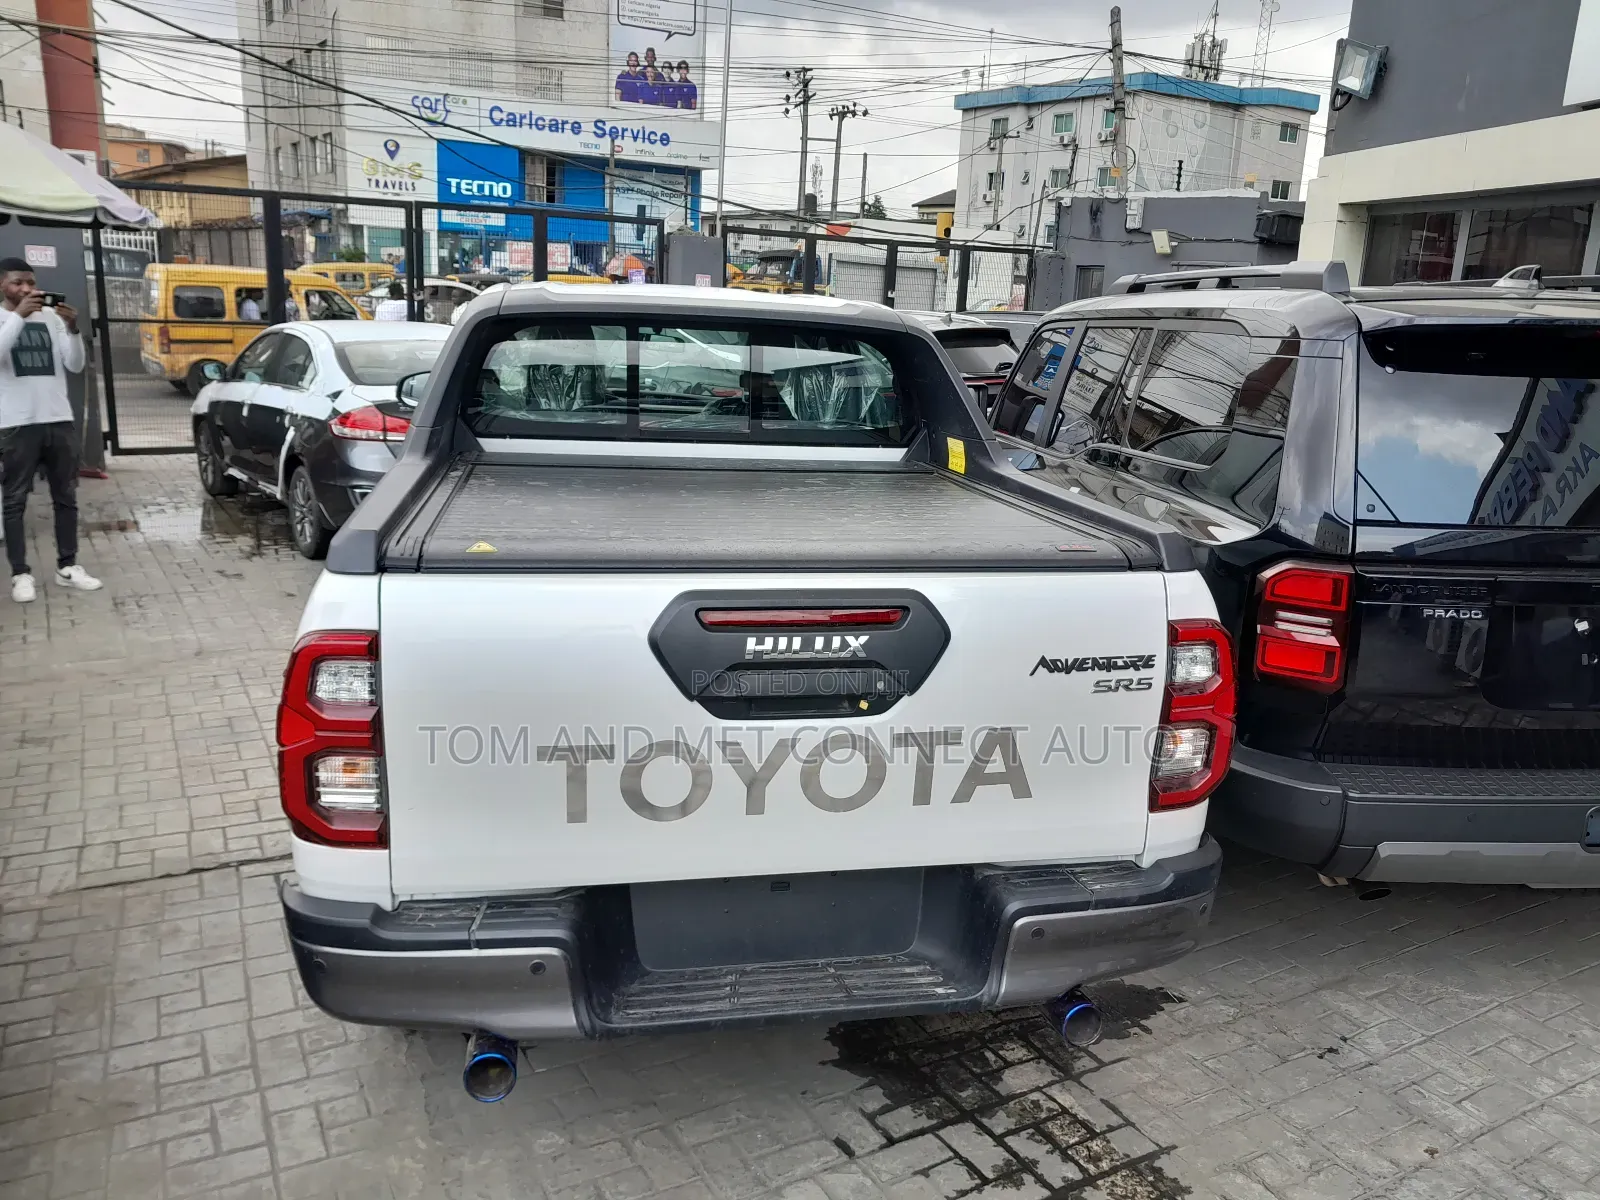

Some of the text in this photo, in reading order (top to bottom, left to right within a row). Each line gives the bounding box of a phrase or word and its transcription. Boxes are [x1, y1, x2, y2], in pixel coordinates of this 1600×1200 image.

[489, 105, 671, 147] Carlcare Service
[367, 178, 418, 192] TRAVELS
[446, 177, 513, 198] TECNO
[28, 249, 53, 263] OUT
[1422, 608, 1483, 619] PRADO
[744, 635, 870, 660] HILUX
[1029, 654, 1157, 677] ADVENTURE
[1090, 676, 1154, 694] SR5
[537, 727, 1033, 823] TOYOTA
